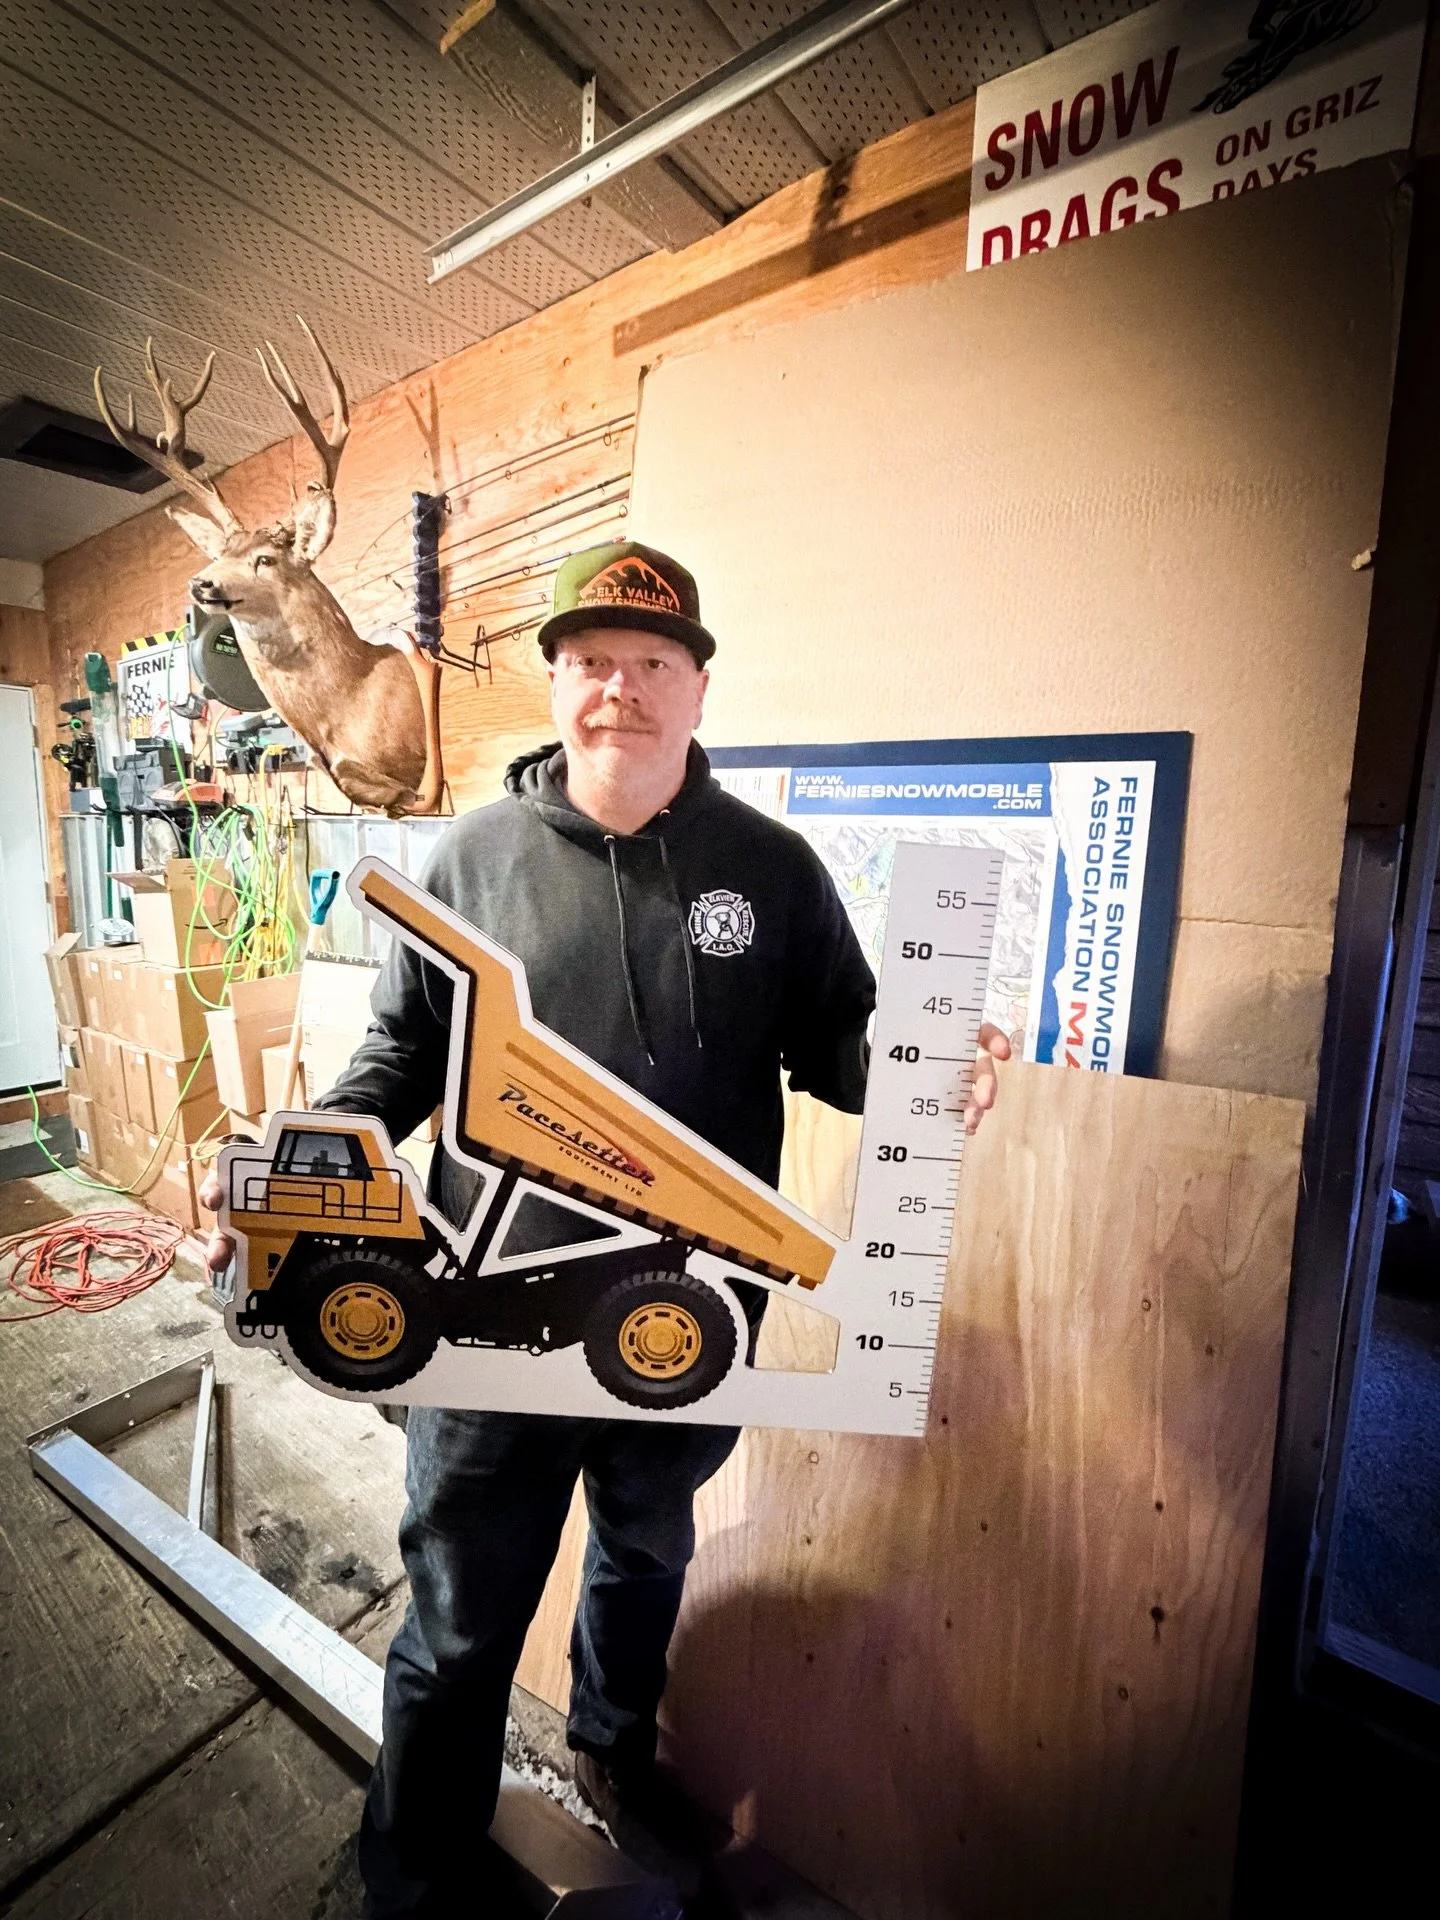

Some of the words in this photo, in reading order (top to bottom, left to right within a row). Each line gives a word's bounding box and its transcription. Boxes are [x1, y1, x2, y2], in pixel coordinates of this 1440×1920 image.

[985, 46, 1180, 191] SNOW
[1215, 119, 1272, 166] ON
[1285, 74, 1384, 140] GRIZ
[596, 586, 622, 598] ELK
[626, 586, 674, 608] VALLEY
[794, 783, 1043, 799] FERNIESNOWMOBILE
[992, 798, 1042, 810] .COM
[1109, 777, 1138, 890] FERNIE
[1072, 776, 1111, 992] ASSOCIATION
[936, 889, 966, 910] 55
[694, 909, 703, 934] MINE
[741, 909, 750, 937] RESCUE
[901, 941, 933, 960] 50
[922, 996, 952, 1016] 45
[888, 1045, 920, 1063] 40
[910, 1097, 939, 1116] 35
[497, 1082, 656, 1187] Pacesetter
[877, 1145, 907, 1163] 30
[558, 1145, 619, 1183] EQUIPMENT
[898, 1196, 927, 1214] 25
[865, 1242, 895, 1259] 20
[888, 1290, 915, 1308] 15
[855, 1334, 884, 1351] 10
[889, 1382, 902, 1398] 5
